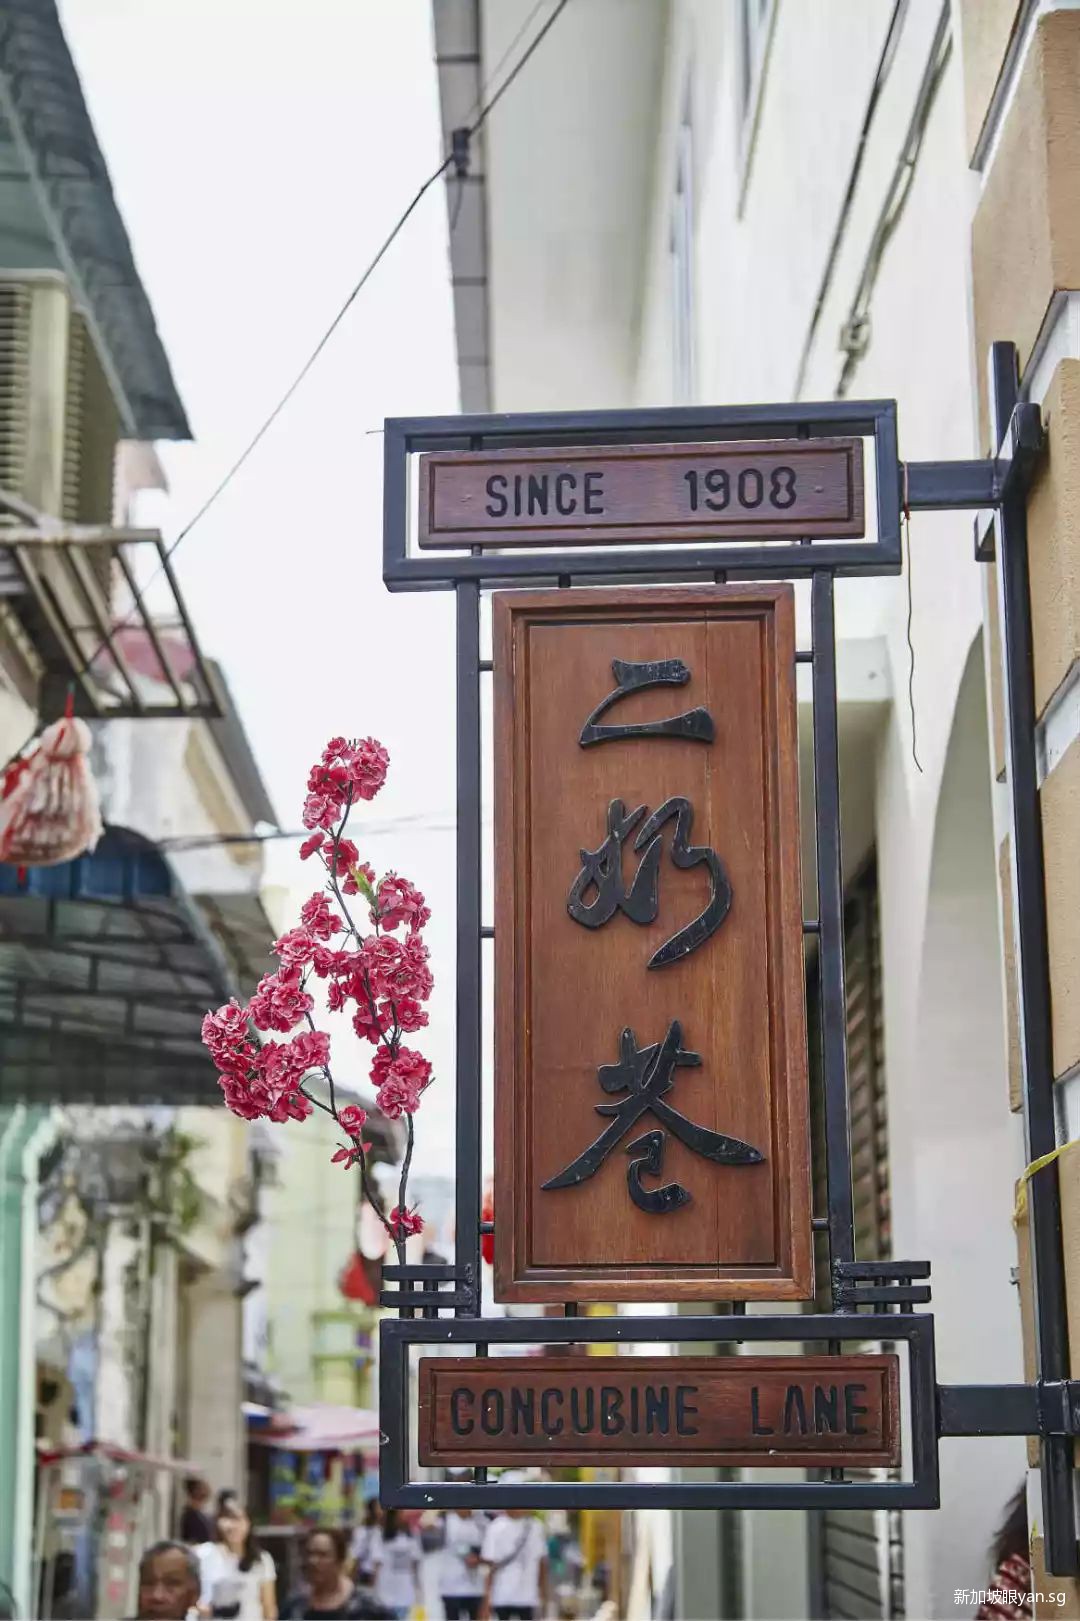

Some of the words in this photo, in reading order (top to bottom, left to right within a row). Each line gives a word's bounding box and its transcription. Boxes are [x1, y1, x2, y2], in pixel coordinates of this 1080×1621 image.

[485, 472, 605, 518] SINCE
[684, 466, 798, 511] 1908
[541, 658, 766, 1213] 二奶巷
[450, 1385, 699, 1437] CONCUBINE
[750, 1383, 869, 1437] LANE
